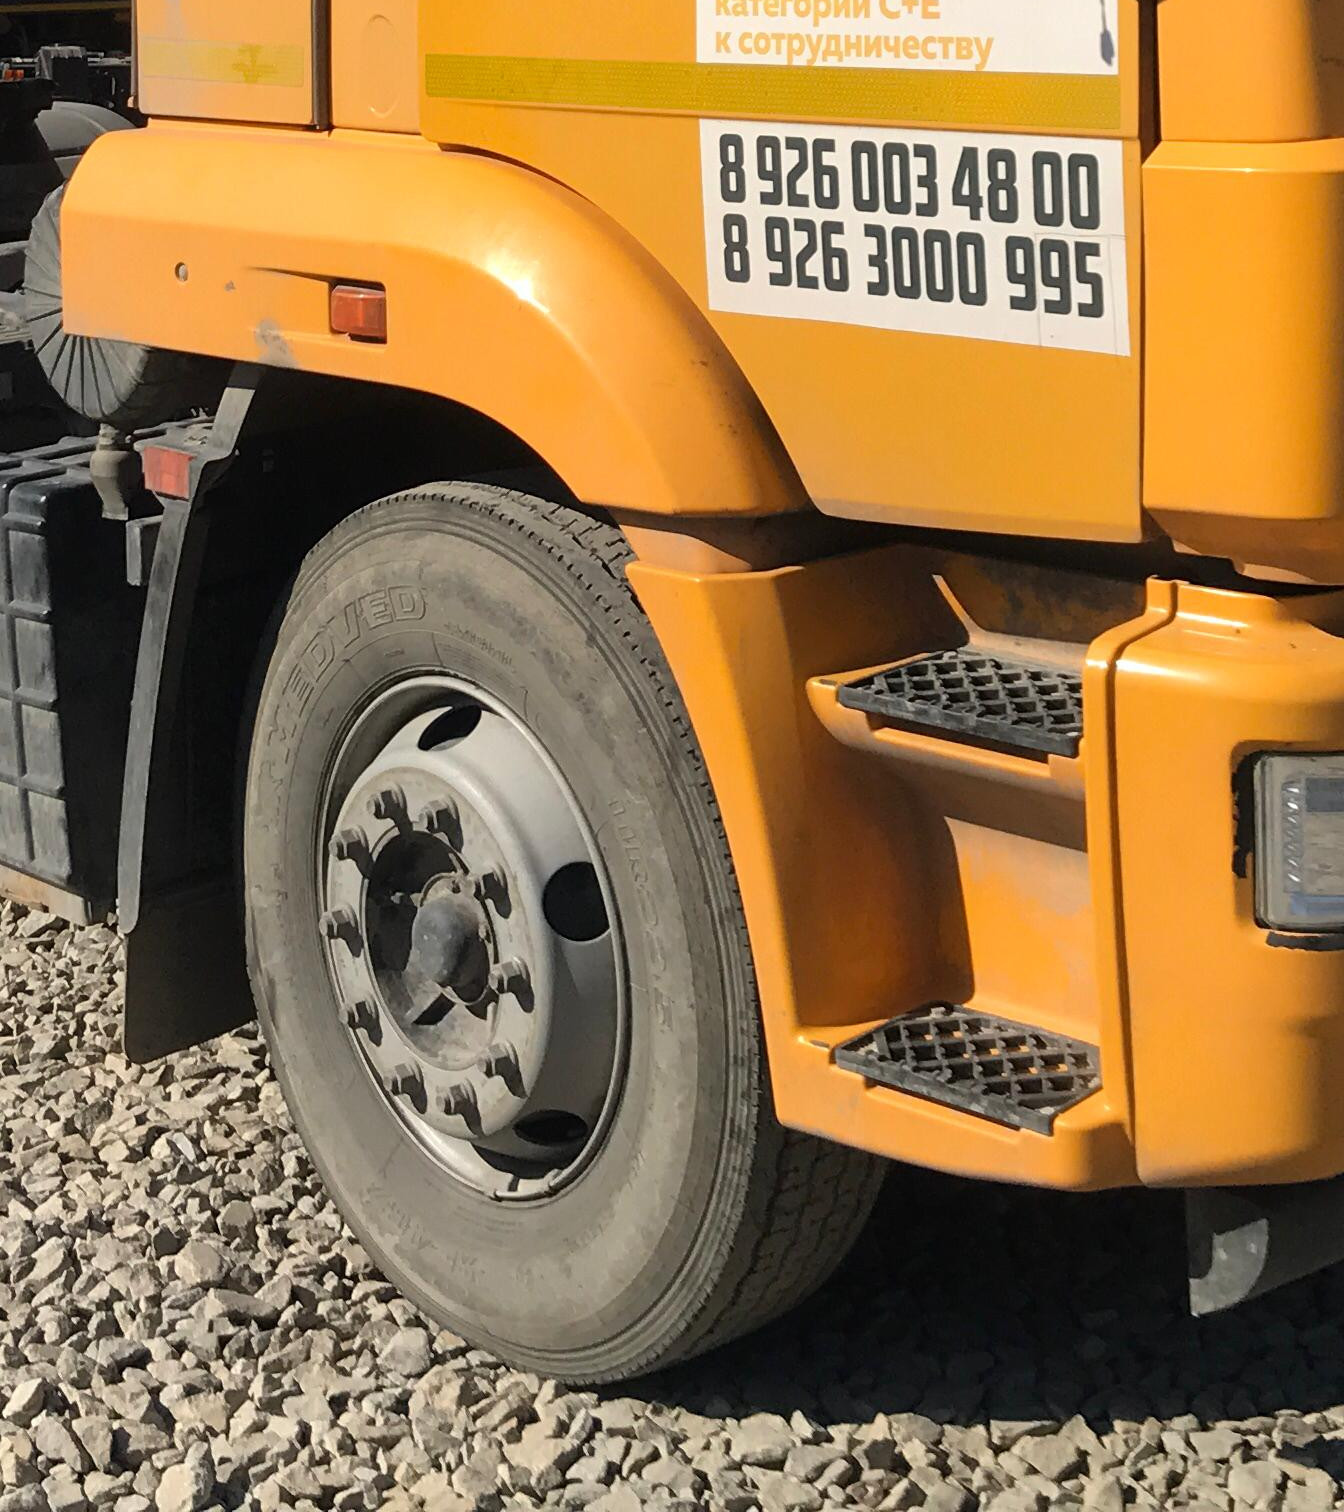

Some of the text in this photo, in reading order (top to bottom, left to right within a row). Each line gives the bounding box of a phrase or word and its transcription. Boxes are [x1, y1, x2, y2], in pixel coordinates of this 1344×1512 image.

[715, 30, 995, 71] к сотрудничеству
[719, 133, 1101, 231] 8 926 003 48 00
[723, 213, 1105, 319] 8 926 3000 995
